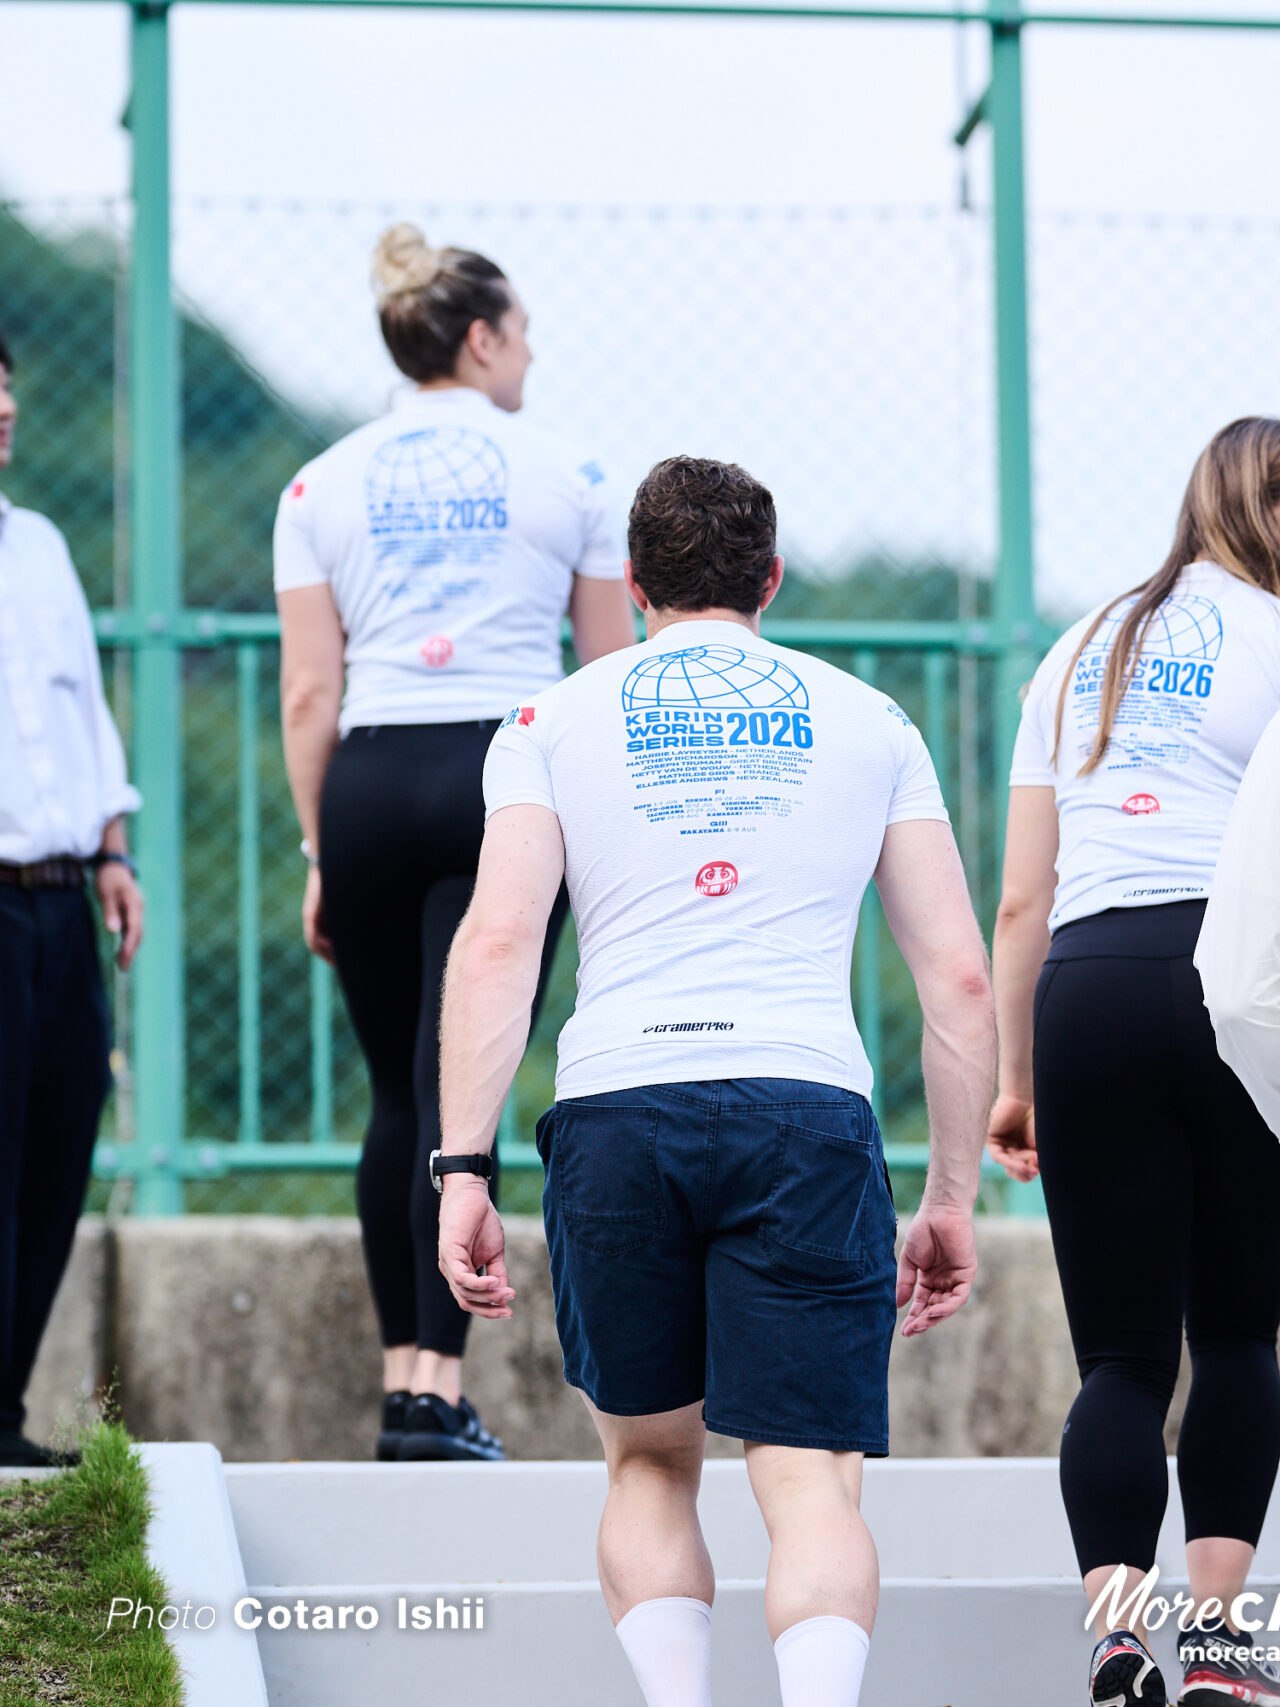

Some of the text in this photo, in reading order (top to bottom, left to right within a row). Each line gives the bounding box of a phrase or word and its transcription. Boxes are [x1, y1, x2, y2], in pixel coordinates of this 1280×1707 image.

[445, 497, 507, 530] 2026
[1148, 659, 1214, 699] 2026
[625, 711, 813, 749] KEIRIN 2026
[625, 724, 723, 739] WORLD
[626, 736, 724, 753] SERIES
[735, 749, 804, 757] NETHERLANDS
[626, 757, 673, 767] MATTHEW
[777, 755, 813, 764] BRITAIN
[641, 761, 679, 771] JOSEPH
[762, 759, 798, 767] BRITAIN
[631, 769, 662, 778] HETTY
[739, 764, 807, 775] NETHERLANDS
[659, 771, 707, 780] MATHILDE
[636, 779, 677, 789] ELLESSE
[760, 776, 803, 785] ZEALAND
